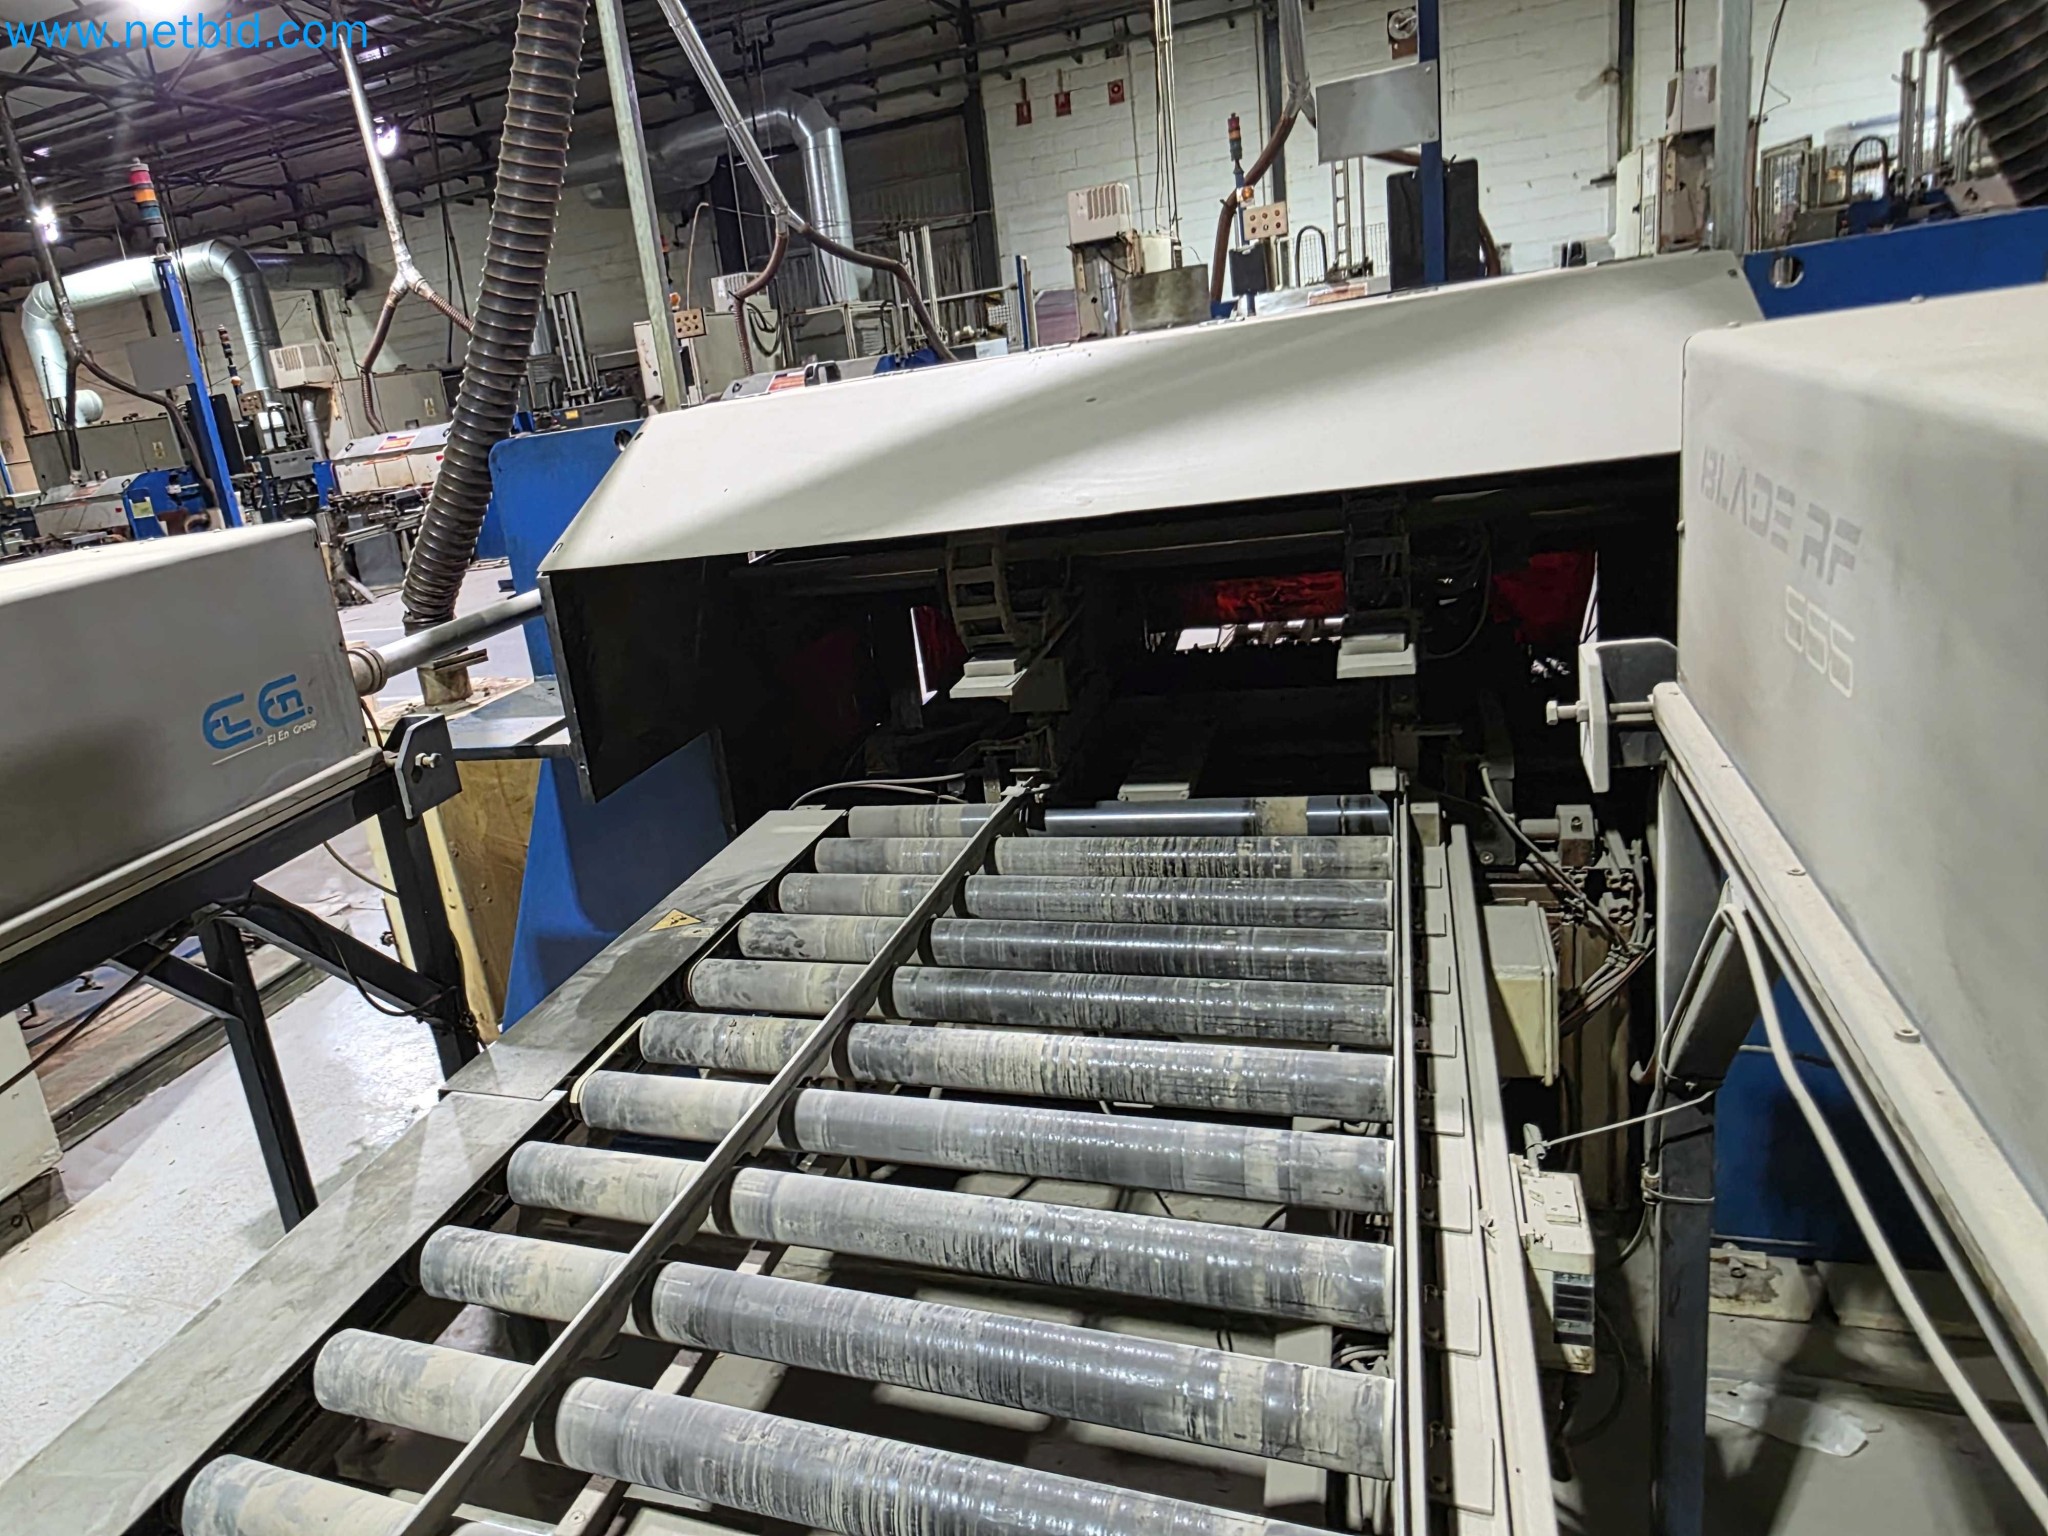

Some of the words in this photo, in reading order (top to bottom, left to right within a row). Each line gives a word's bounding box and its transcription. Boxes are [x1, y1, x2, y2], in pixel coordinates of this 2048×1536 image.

[1700, 446, 1796, 554] BLADE
[1801, 502, 1863, 586] RF
[278, 730, 290, 741] En
[292, 719, 317, 734] Group
